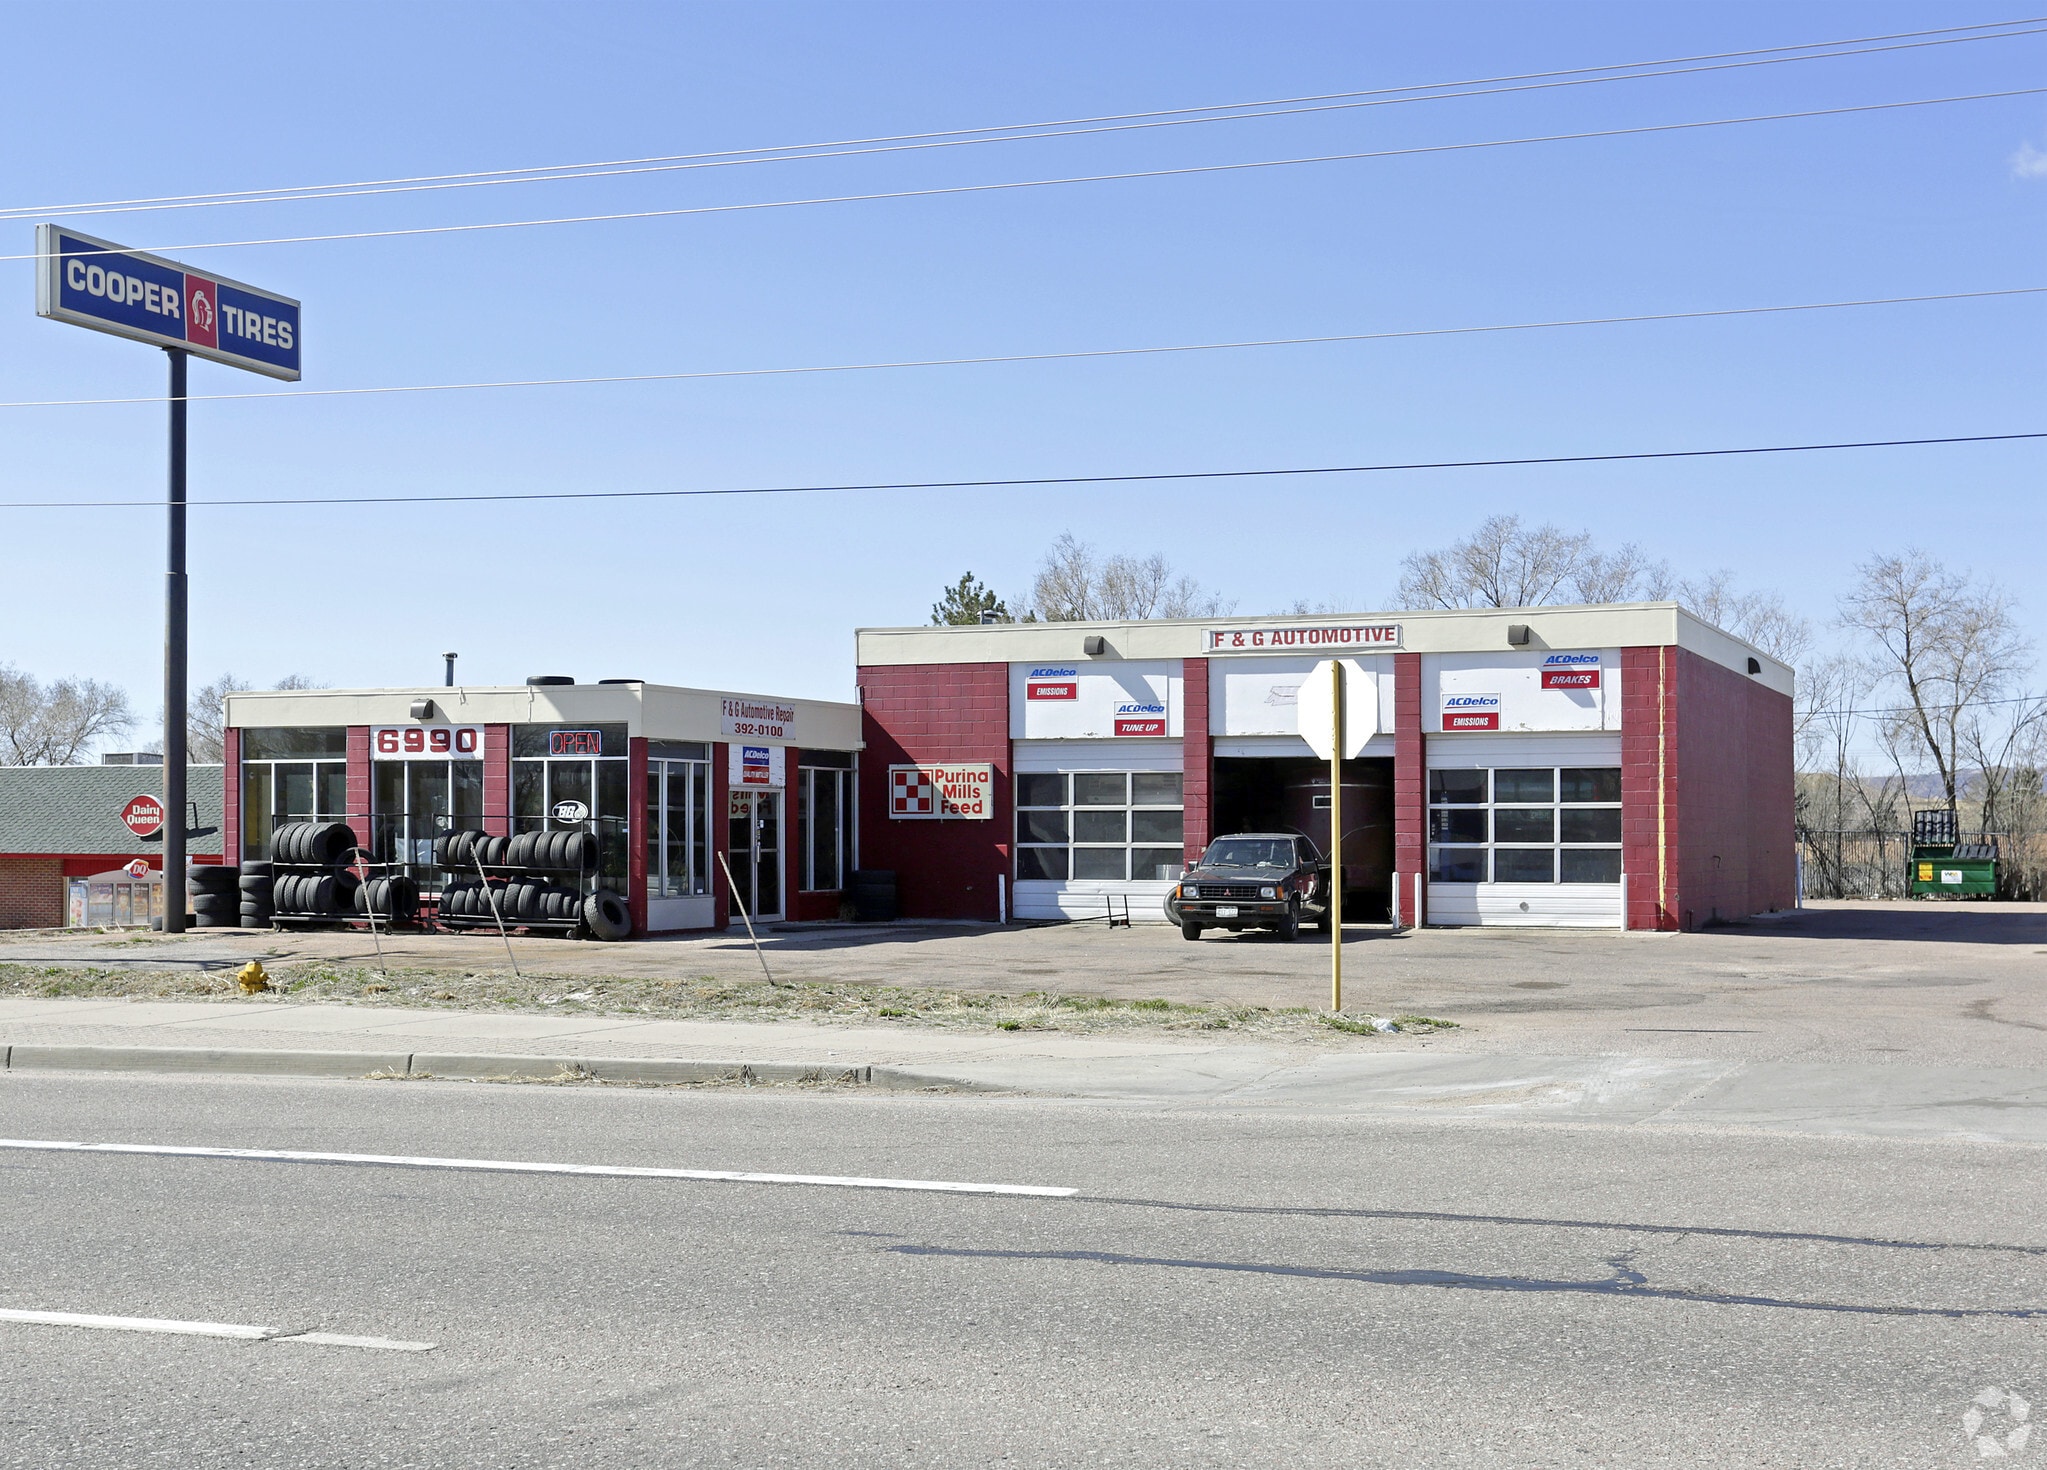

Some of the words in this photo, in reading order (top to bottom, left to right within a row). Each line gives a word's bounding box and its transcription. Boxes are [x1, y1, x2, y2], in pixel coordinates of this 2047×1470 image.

[67, 258, 180, 319] COOPER
[222, 304, 294, 350] TIRES
[1214, 632, 1225, 648] F
[1232, 632, 1245, 647] &
[1252, 631, 1264, 647] G
[1271, 627, 1396, 646] AUTOMOTIVE
[1545, 654, 1599, 664] ACDelco
[1031, 668, 1076, 677] ACDelco
[1549, 675, 1592, 684] BRAKES
[1036, 687, 1068, 696] EMISSIONS
[1446, 696, 1498, 706] ACDelco
[722, 700, 727, 716] F
[728, 701, 733, 717] &
[734, 701, 740, 717] G
[740, 702, 774, 721] Automotive
[775, 705, 794, 725] Repair
[1118, 704, 1165, 713] ACDelco
[1453, 717, 1489, 726] EMISSIONS
[734, 722, 783, 737] 392-0100
[1121, 724, 1144, 732] TUNE
[1145, 724, 1159, 732] UP
[377, 728, 477, 753] 6990
[551, 732, 599, 754] OPEN
[744, 749, 769, 760] ACDelco
[935, 769, 988, 783] Purina
[943, 784, 981, 799] Mills
[132, 804, 160, 816] Dairy
[941, 799, 983, 815] Feed
[127, 815, 160, 825] Queen
[133, 864, 146, 875] DQ
